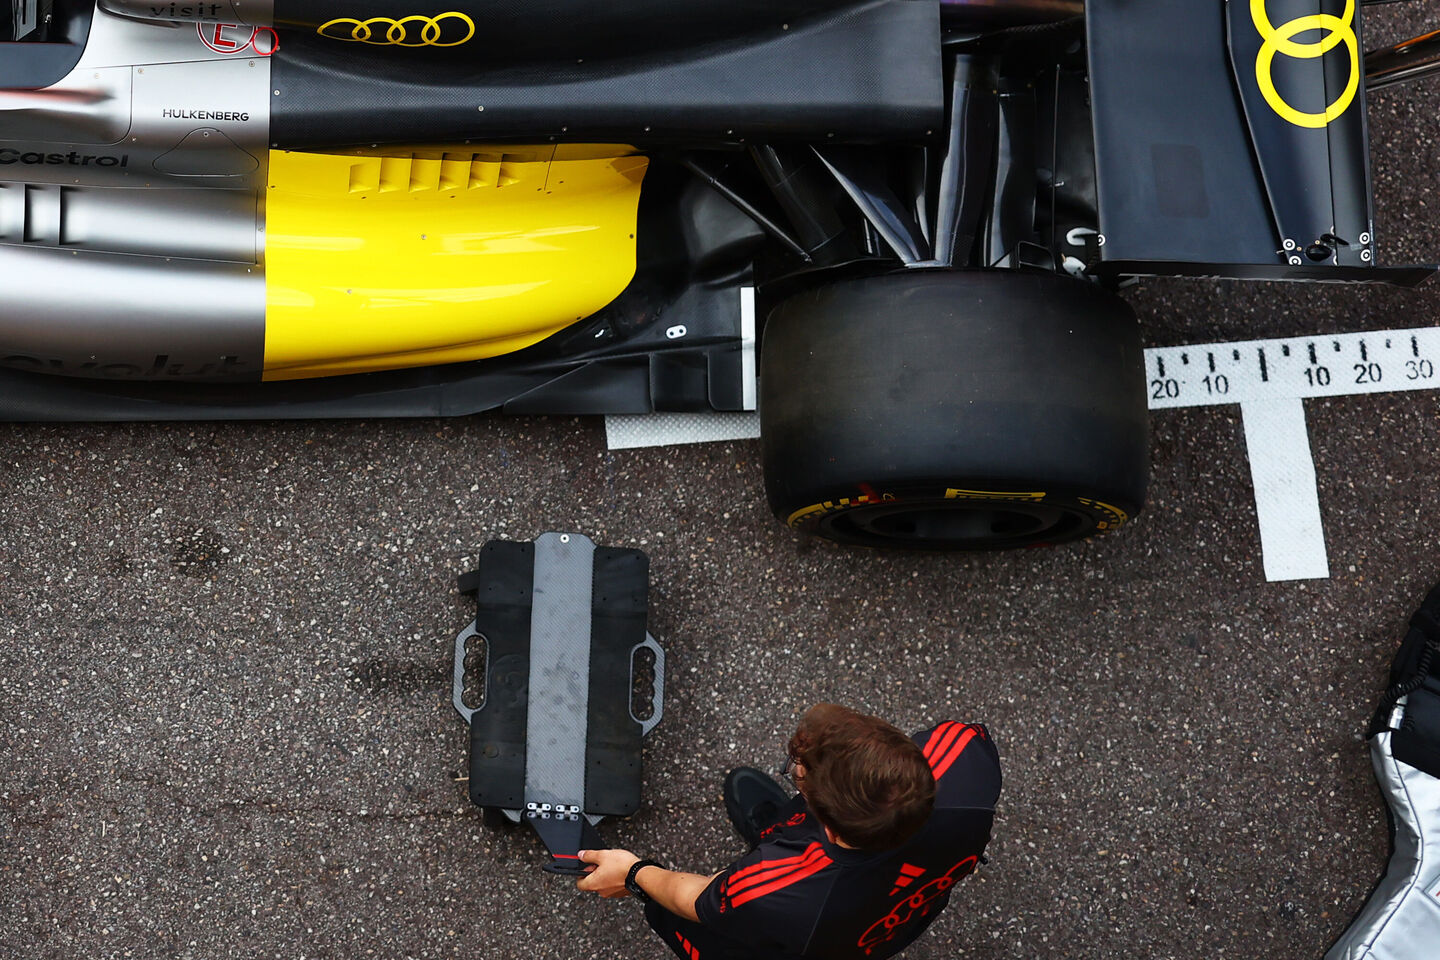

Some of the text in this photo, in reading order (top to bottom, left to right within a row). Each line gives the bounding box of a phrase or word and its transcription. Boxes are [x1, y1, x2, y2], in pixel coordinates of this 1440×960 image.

[150, 2, 222, 17] visit
[162, 108, 250, 122] HULKENBERG
[1151, 359, 1434, 399] 20 10 10 20 30
